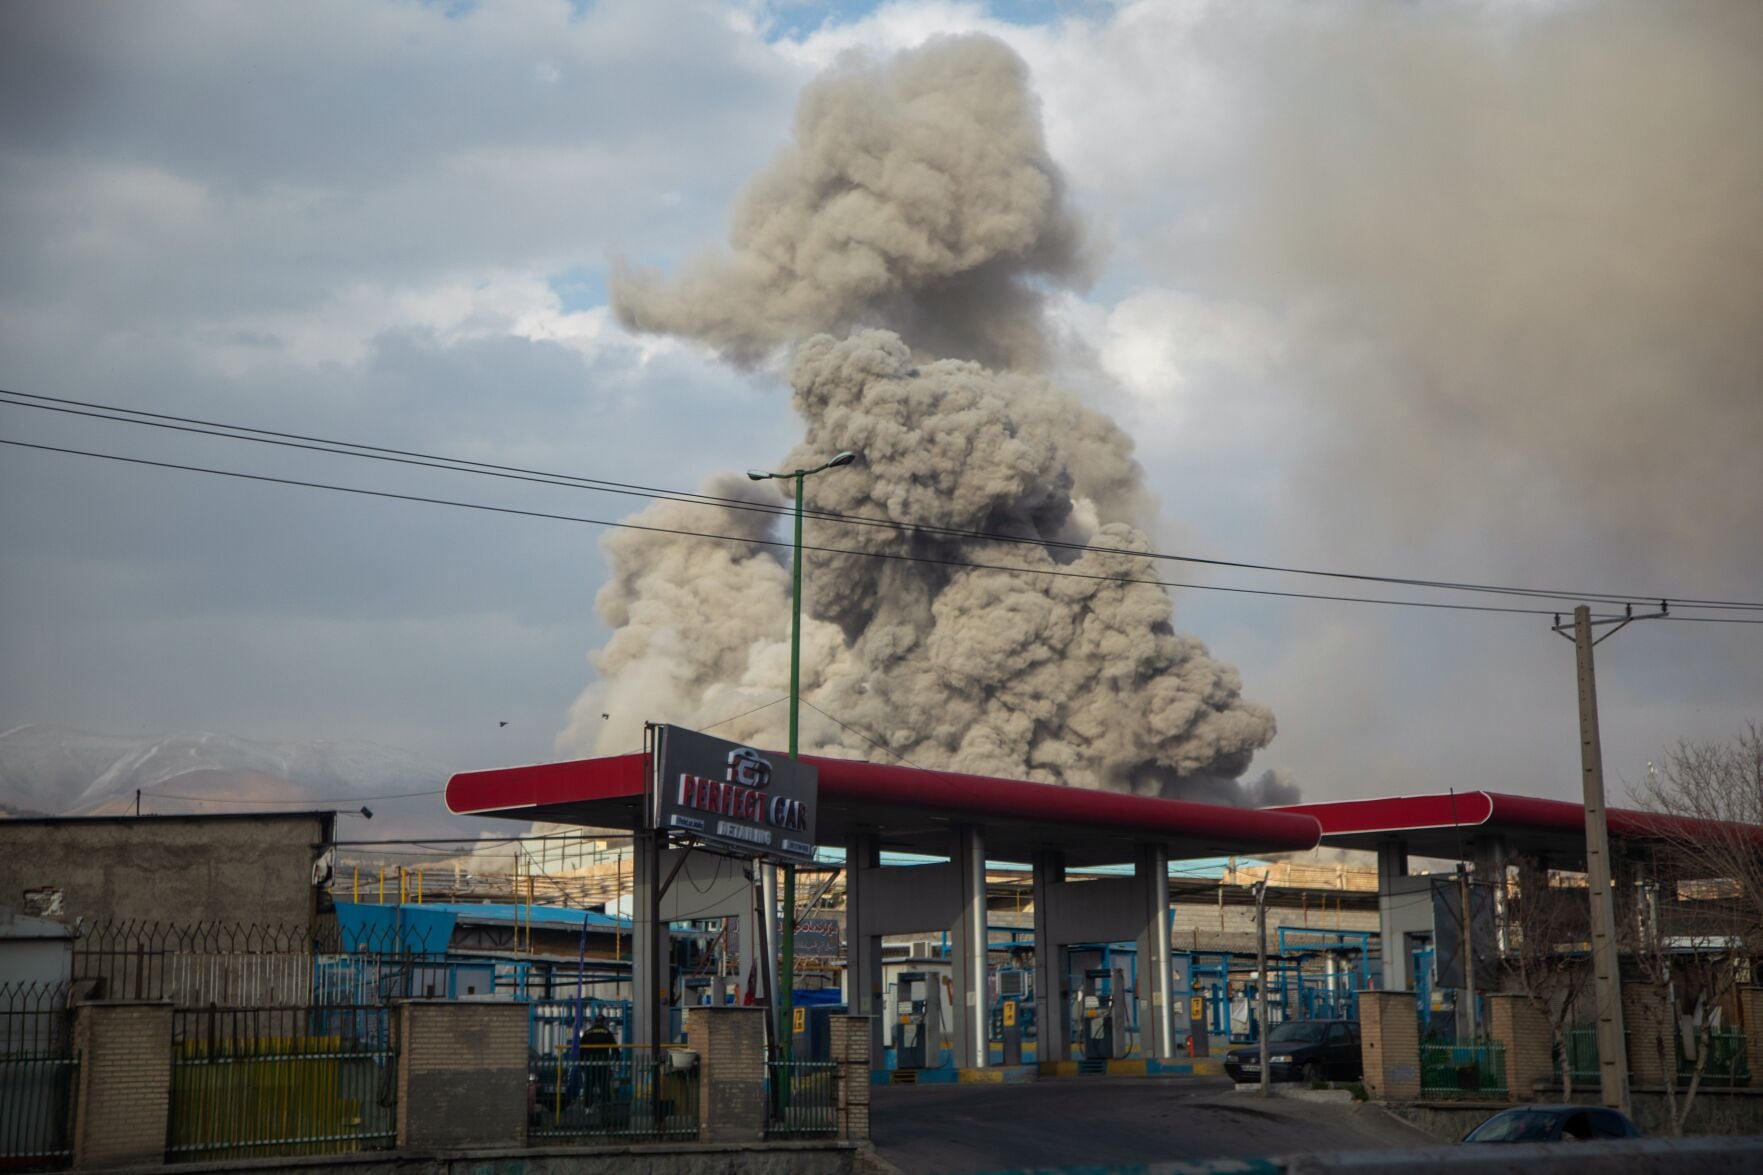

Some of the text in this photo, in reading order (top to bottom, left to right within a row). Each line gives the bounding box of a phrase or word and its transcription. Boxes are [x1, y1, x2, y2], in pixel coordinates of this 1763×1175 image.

[678, 773, 807, 832] PERFECT CAR
[717, 821, 772, 845] DETAILING
